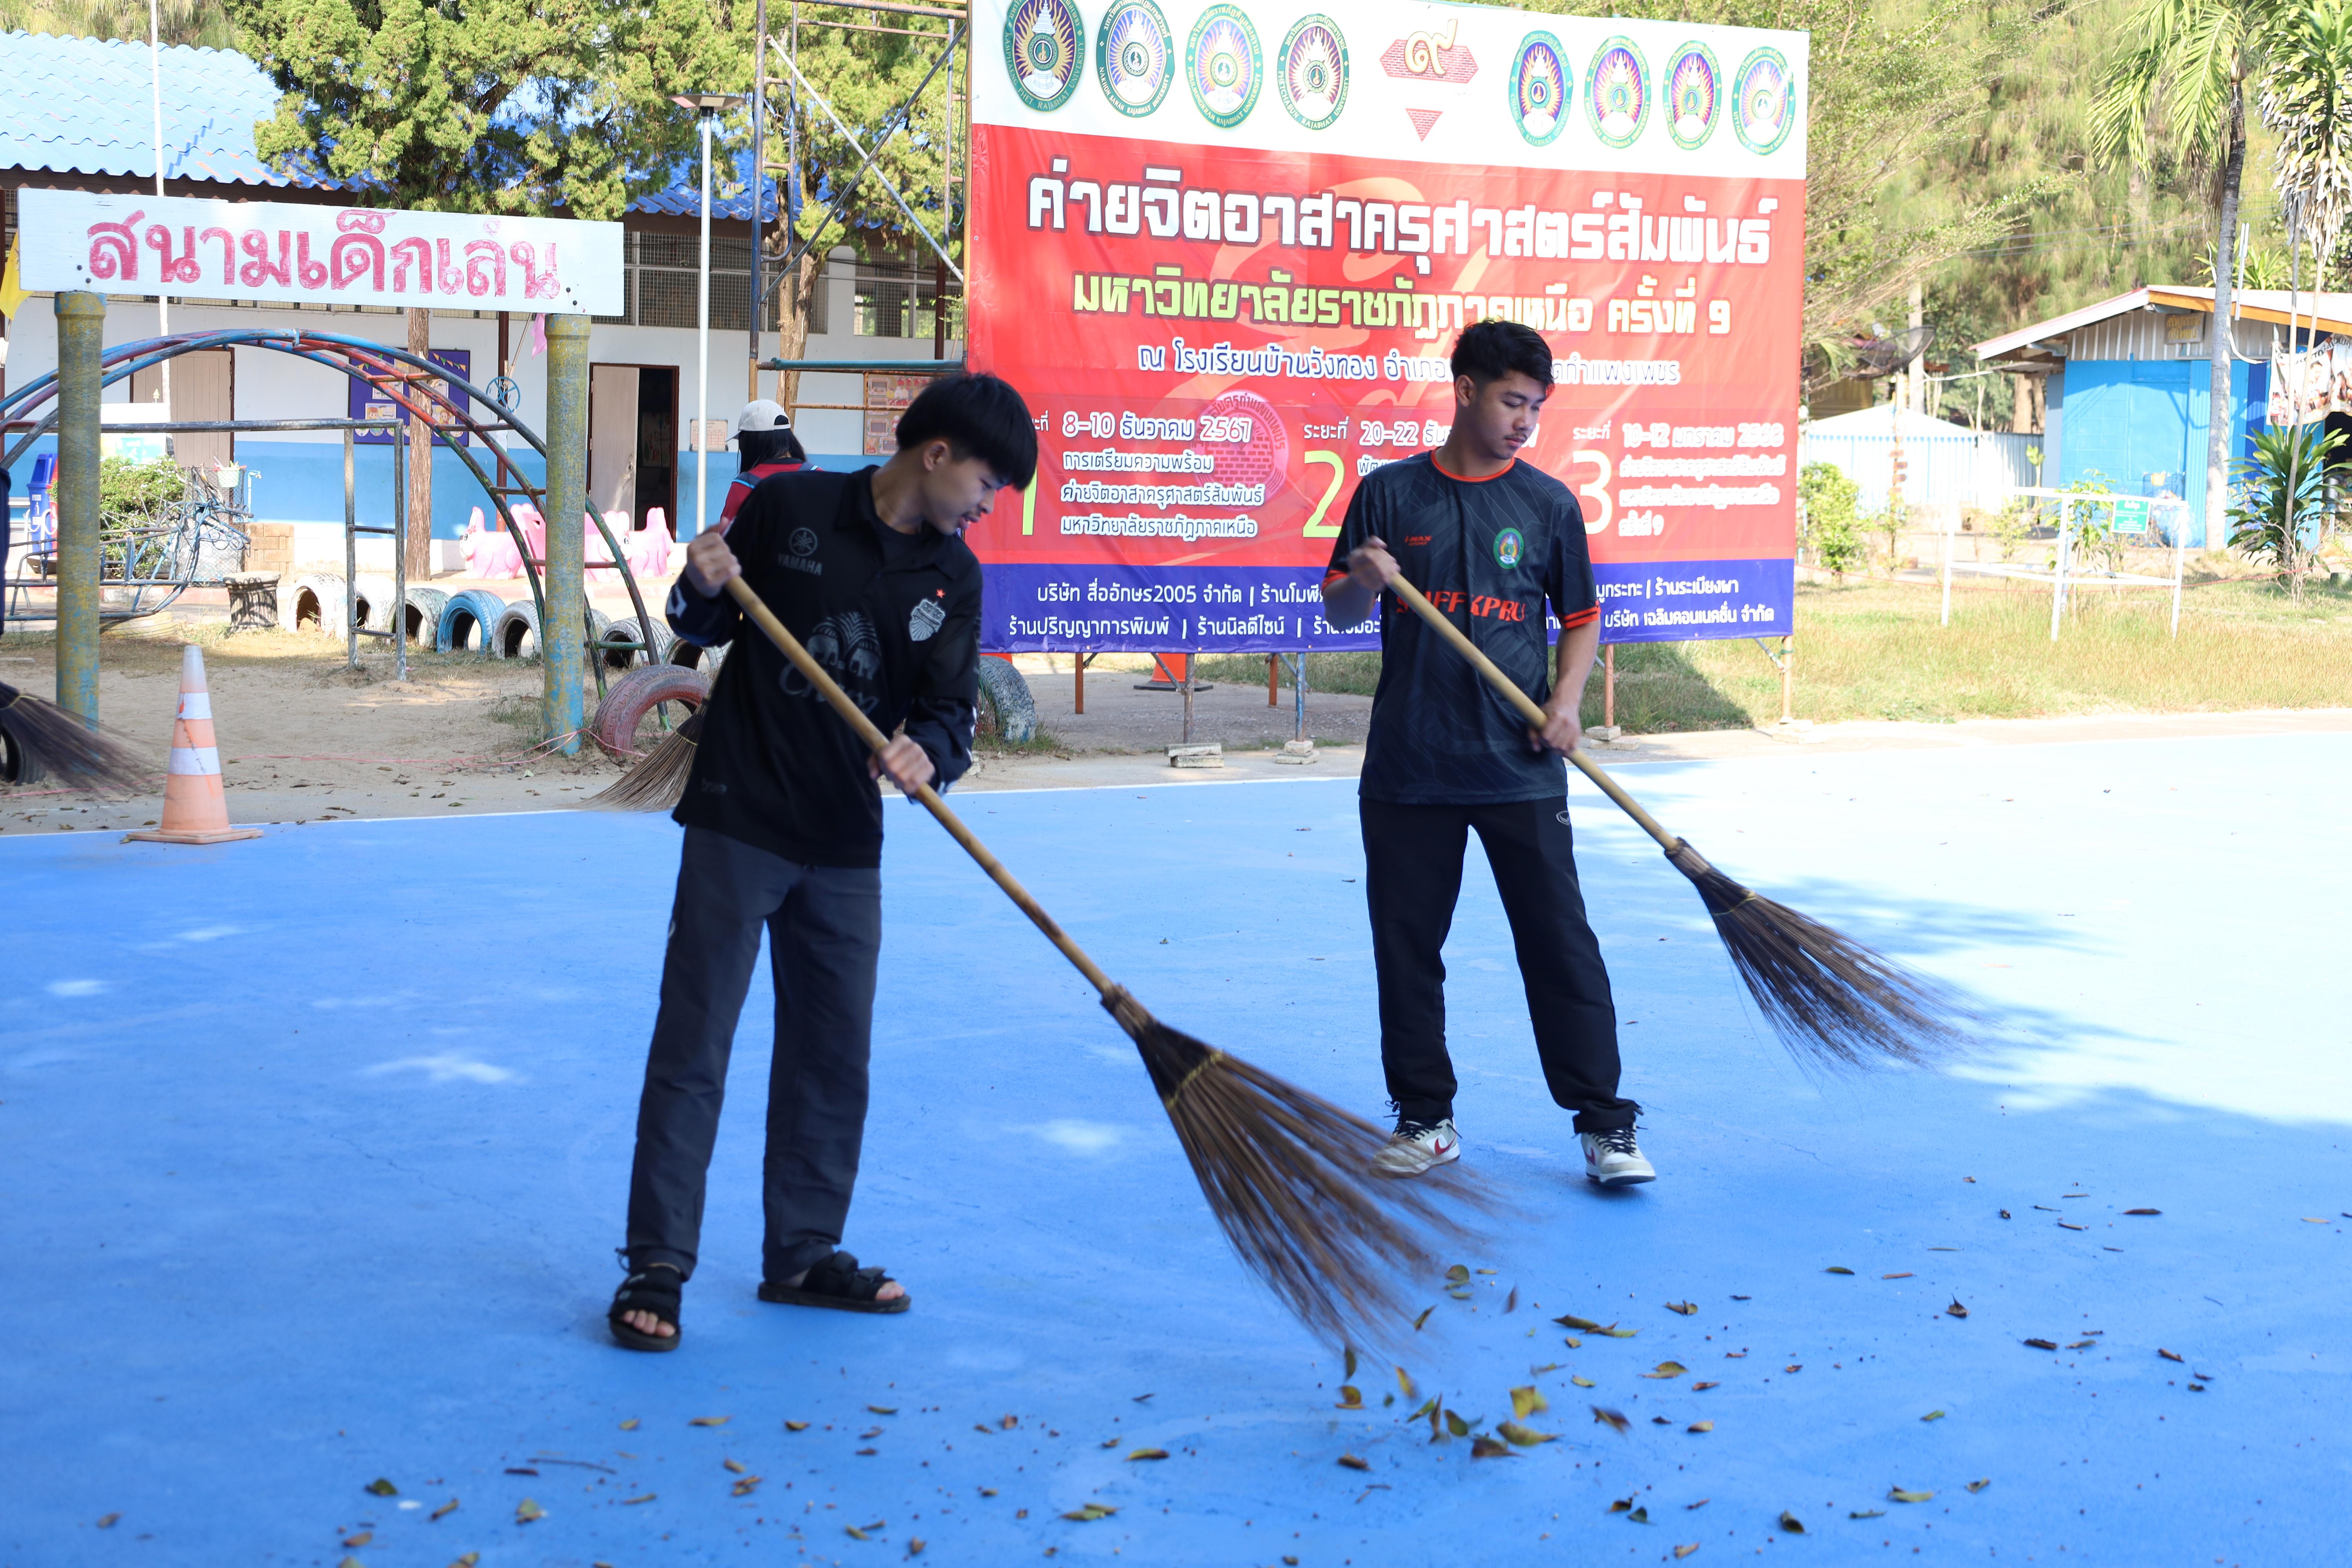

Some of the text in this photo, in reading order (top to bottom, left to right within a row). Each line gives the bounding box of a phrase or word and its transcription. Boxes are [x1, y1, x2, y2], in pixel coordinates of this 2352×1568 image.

[1004, 32, 1085, 112] KAMPHAENG PHET RAJABHAT UNIVERSITY
[1098, 66, 1170, 118] NAKHON SAWAN RAJABHAT UNIVERSITY
[1216, 113, 1244, 127] RAJABHAT
[1243, 73, 1262, 113] UNIVERSITY
[1300, 115, 1334, 130] RAJABHAT
[1333, 76, 1349, 116] UNIVERSITY
[1028, 158, 1779, 276] ค่ายจิตอาสาครุศาสตร์สัมพันธ์
[86, 208, 560, 300] สนามเด็กเล่น
[1073, 266, 1731, 340] มหาวิทยาลัยราชภัฏภาคเหนือ ครั้งที่ 9
[1138, 345, 1165, 372] ณ
[1171, 337, 1378, 380] โรงเรียนบ้านวังทอง
[1551, 352, 1681, 385] ดกำแพงเพชร
[1119, 410, 1195, 441] ธันวาคม
[1200, 415, 1253, 443] 2567
[1304, 416, 1349, 439] ระยะที่
[1573, 420, 1611, 440] ระยะที่
[1672, 426, 1735, 447] มกราคม
[1737, 422, 1784, 447] 2568
[1063, 447, 1214, 473] การเตรียมความพร้อม
[1060, 479, 1265, 510] ค่ายจิตอาสาครุศาสตร์สัมพันธ์
[1303, 450, 1345, 538] 2
[1572, 449, 1612, 534] 3
[1060, 512, 1258, 542] มหาวิทยาลัยราชภัฏภาคเหนือ
[777, 553, 822, 576] YAMAHA
[1037, 582, 1080, 602] บริษัท
[1087, 578, 1197, 603] สื่ออักษร2005
[1203, 583, 1242, 604] จำกัด
[1596, 582, 1643, 604] มูกระทะ
[1655, 576, 1739, 596] ร้านระเบียงผา
[1396, 590, 1467, 614] SFF
[1009, 615, 1169, 638] ร้านปริญญาการพิมพ์
[1197, 614, 1285, 635] ร้านนิลดีไซน์
[1605, 608, 1639, 628] บริษัท
[1644, 600, 1737, 626] เฉลิมคอนเนคชั่น
[1740, 603, 1775, 623] จำกัด
